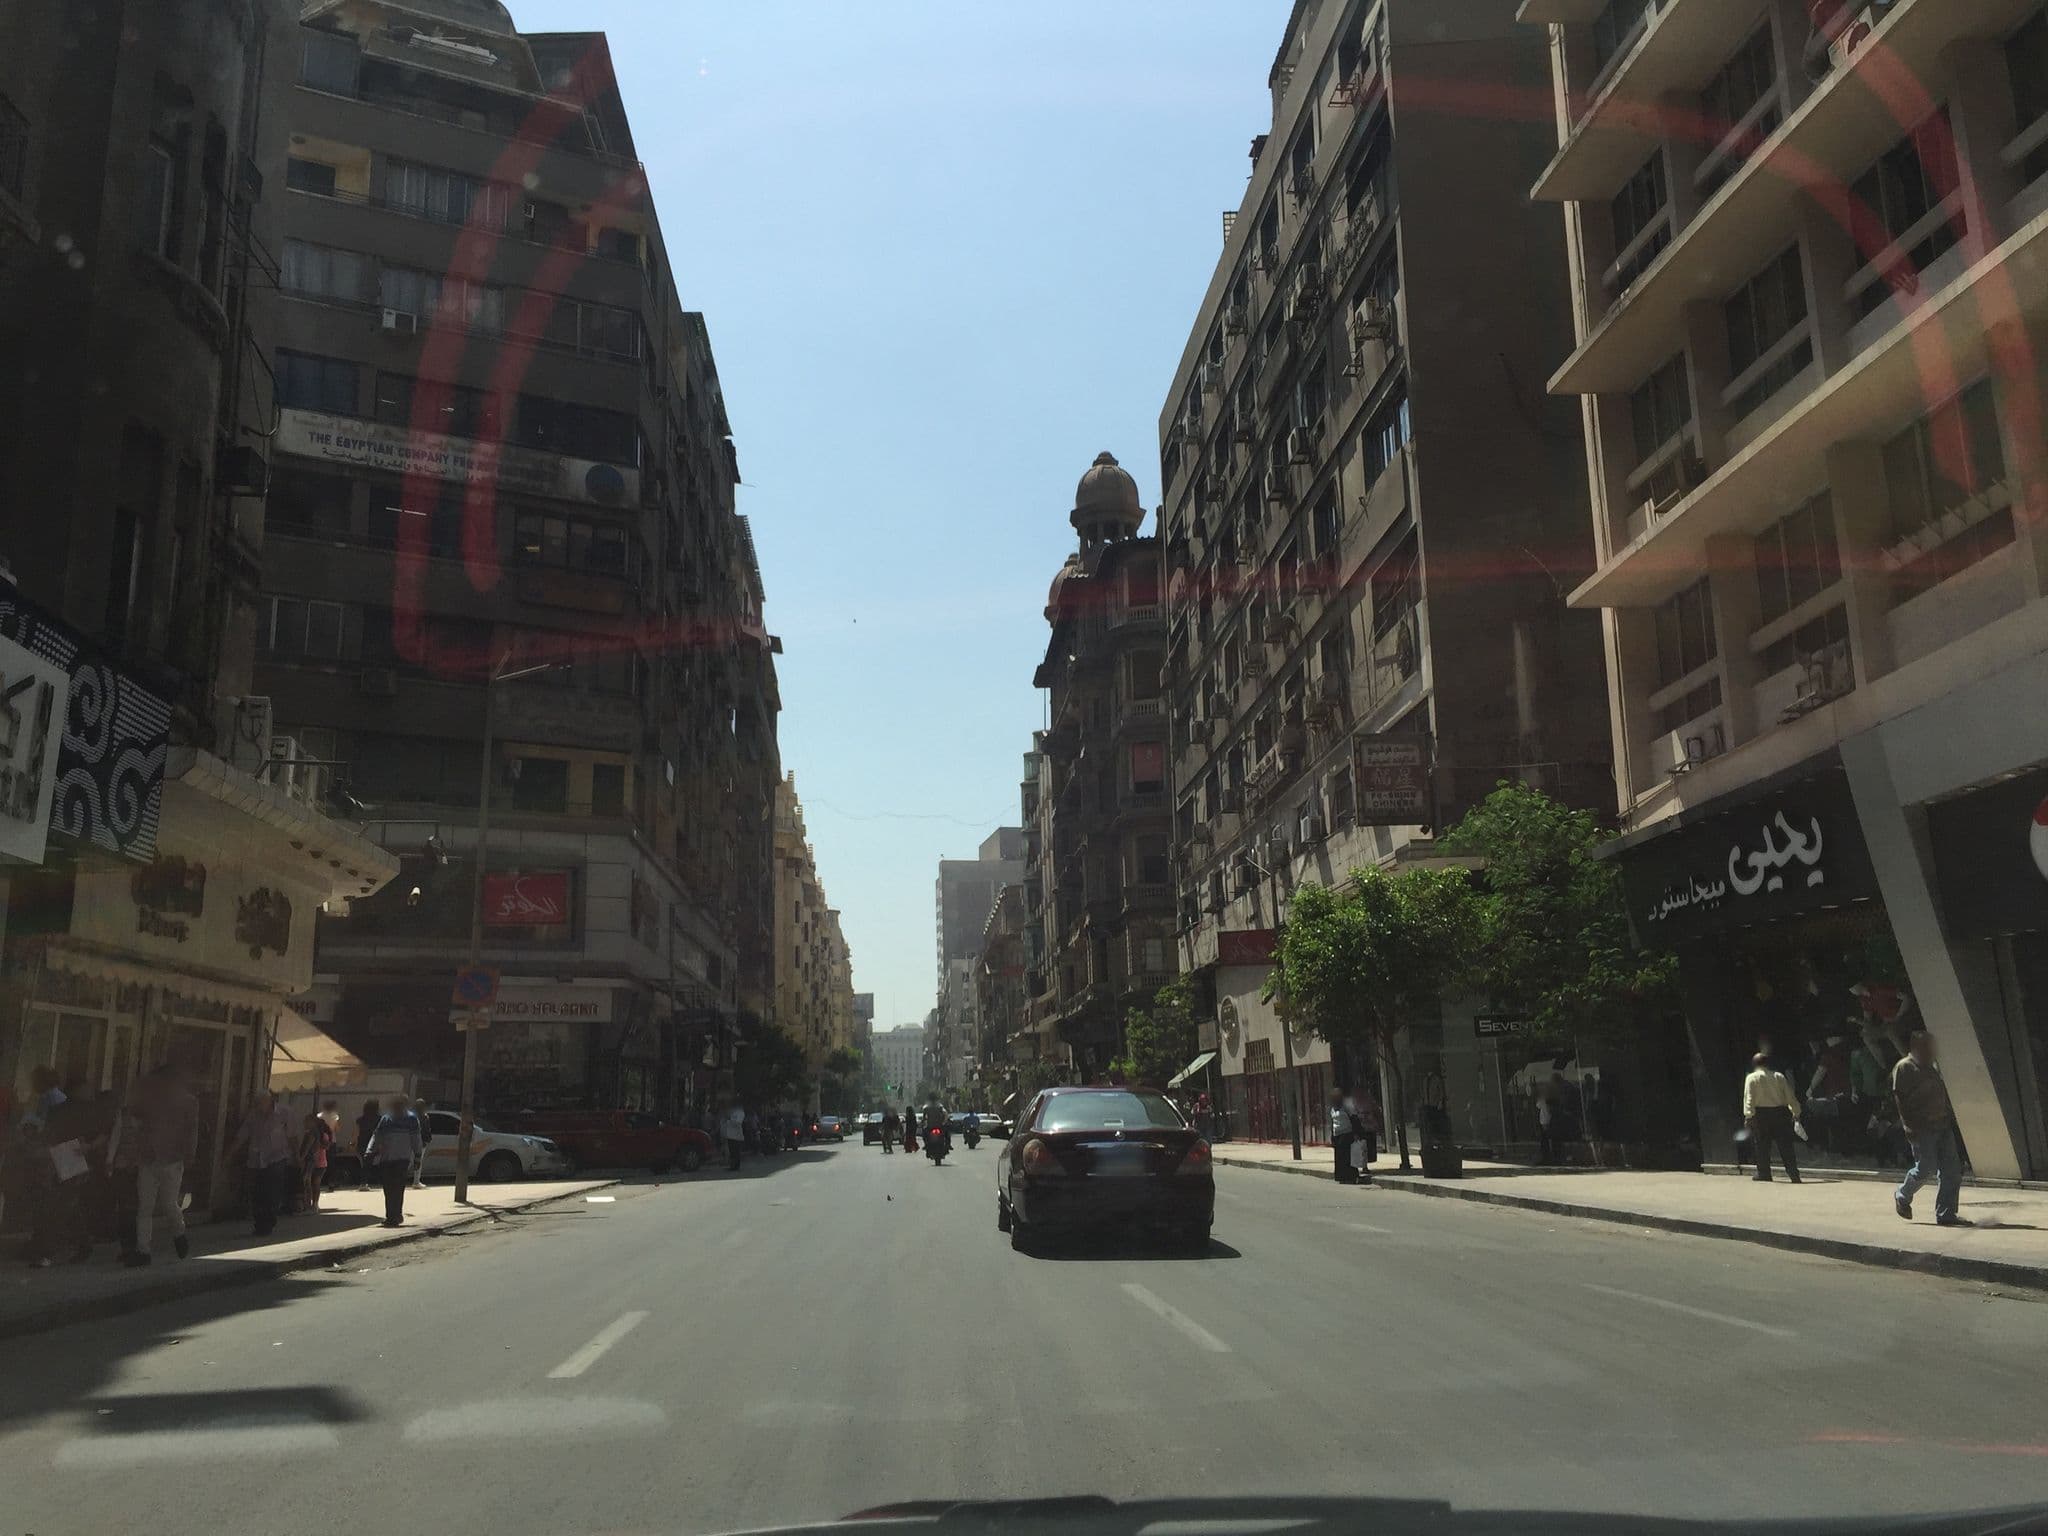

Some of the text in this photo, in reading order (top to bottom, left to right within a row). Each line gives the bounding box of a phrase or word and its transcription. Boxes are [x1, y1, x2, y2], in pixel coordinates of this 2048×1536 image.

[308, 431, 332, 446] THE
[335, 435, 395, 456] EGYPTIAN
[398, 446, 450, 465] COMPANY
